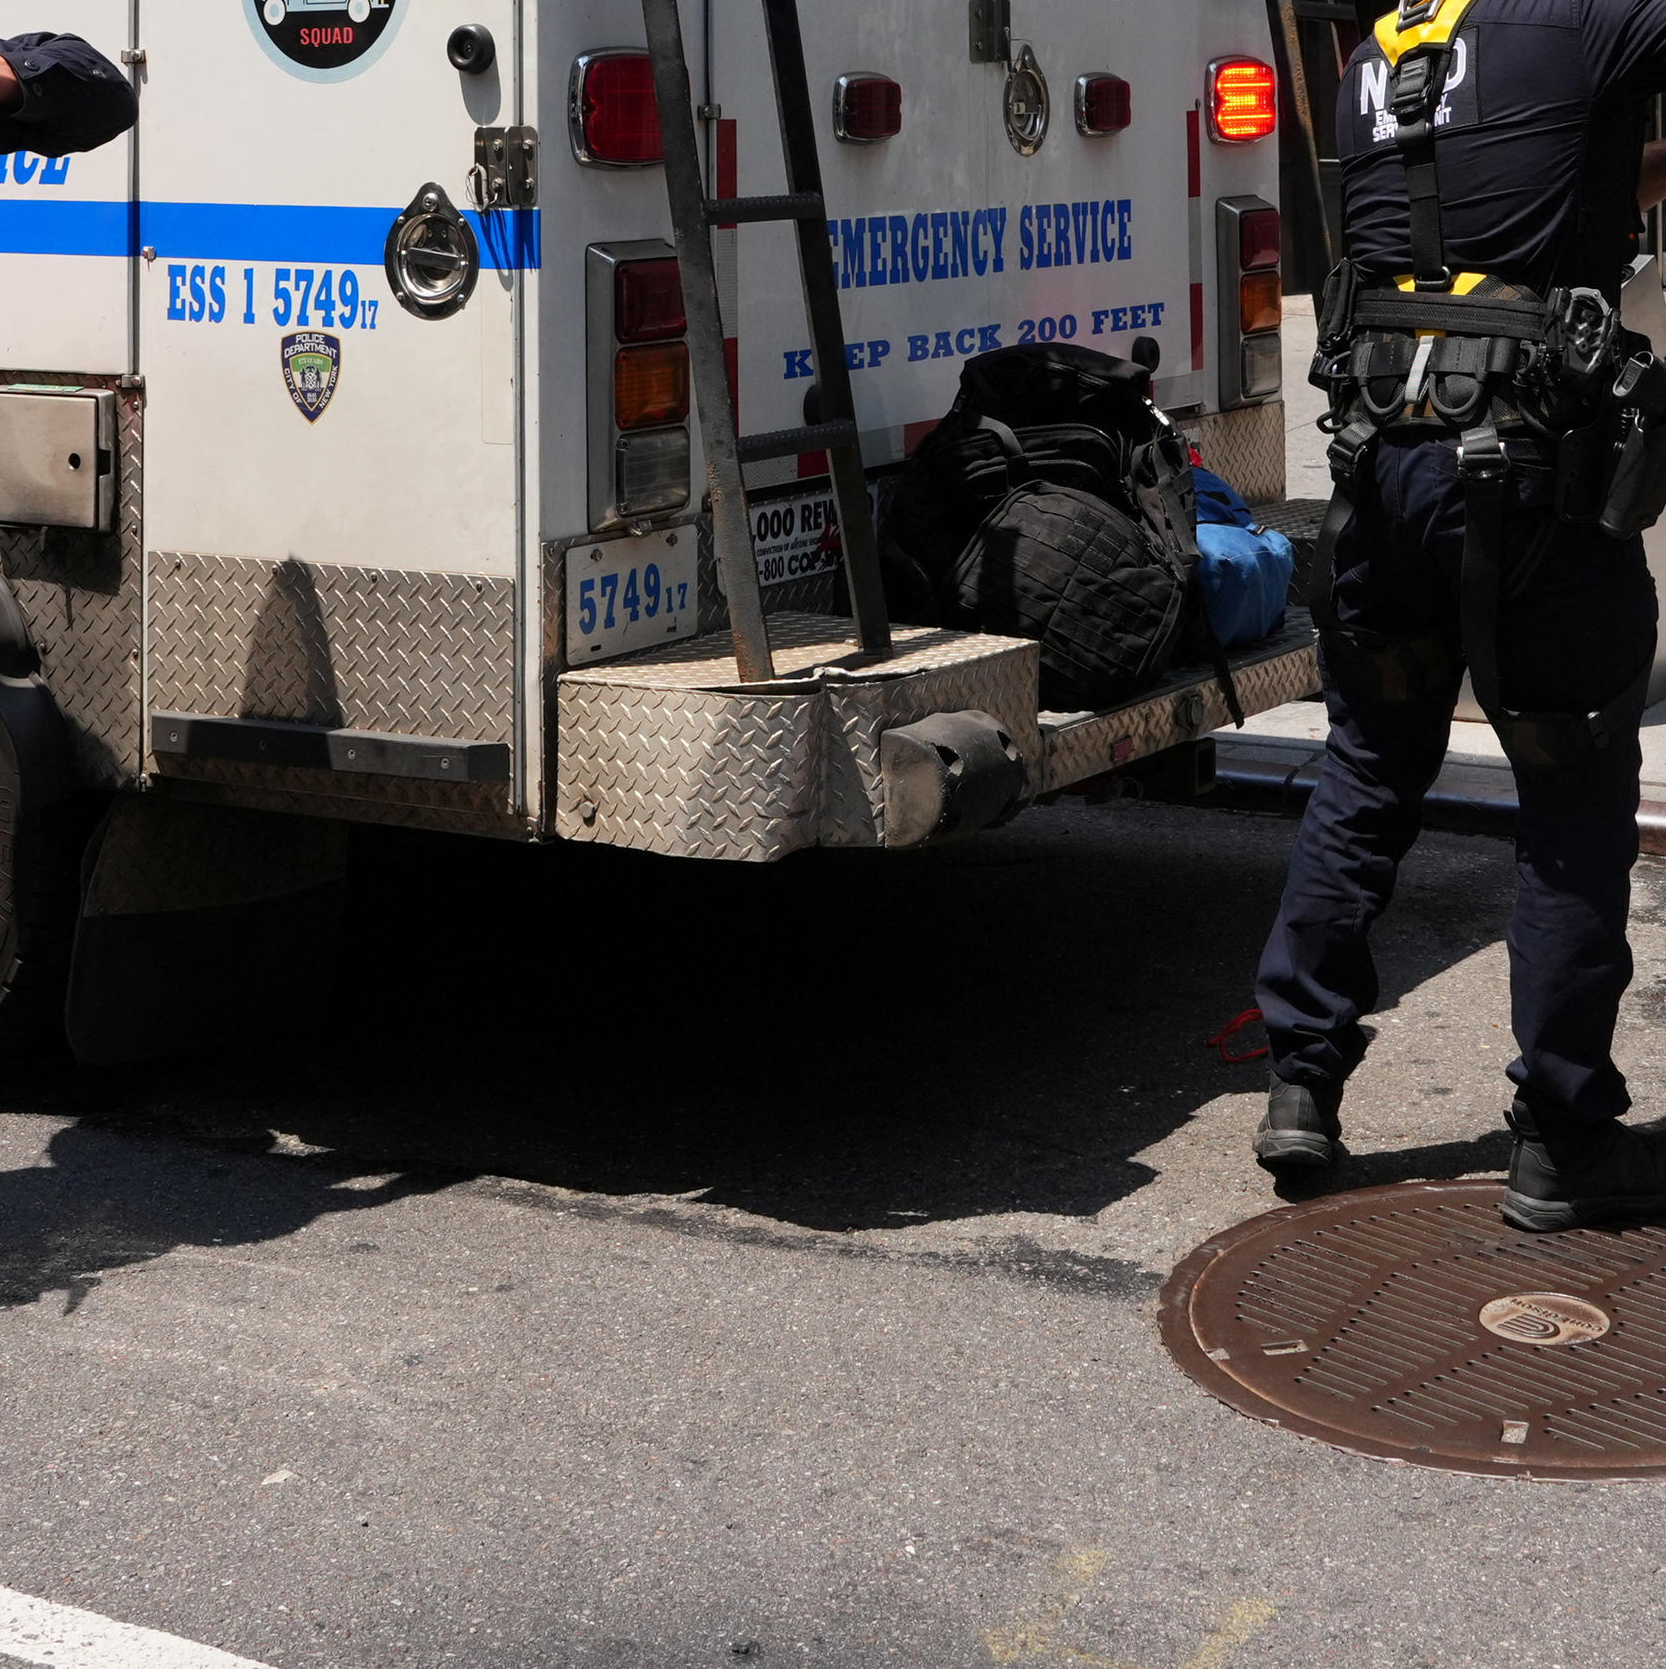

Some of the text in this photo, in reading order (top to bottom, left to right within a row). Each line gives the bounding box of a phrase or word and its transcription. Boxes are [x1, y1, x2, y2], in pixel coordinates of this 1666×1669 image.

[300, 26, 354, 47] SQUAD
[1360, 37, 1467, 116] ND
[1434, 106, 1452, 127] NIT
[1020, 199, 1132, 271] SERVICE
[167, 264, 226, 323] ESS
[284, 342, 337, 359] DEPARTMENT
[296, 333, 325, 344] POLICE
[784, 302, 1165, 379] KEP BACK 200 FEET
[284, 367, 302, 404] CITY OF
[319, 365, 338, 409] NEW YORK
